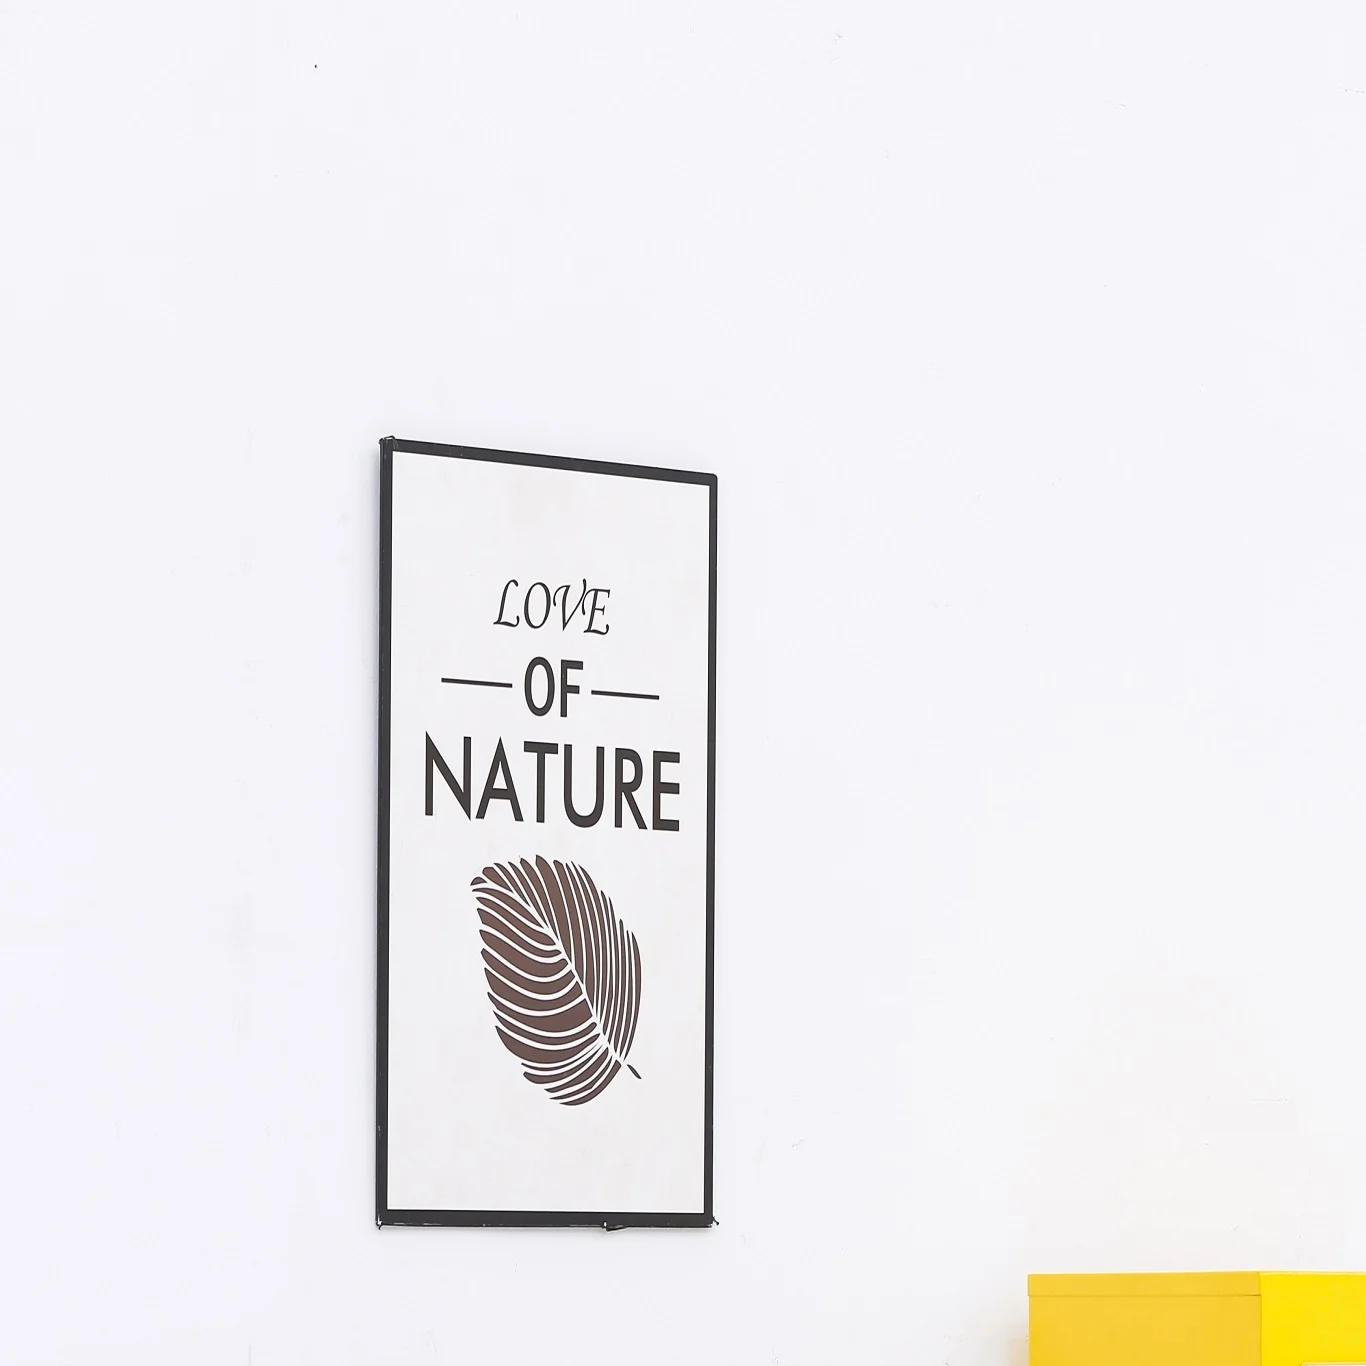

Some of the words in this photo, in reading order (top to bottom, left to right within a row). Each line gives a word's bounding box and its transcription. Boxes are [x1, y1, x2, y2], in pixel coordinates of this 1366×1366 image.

[493, 578, 611, 635] LOVE
[524, 656, 584, 718] OF
[425, 730, 680, 832] NATURE
